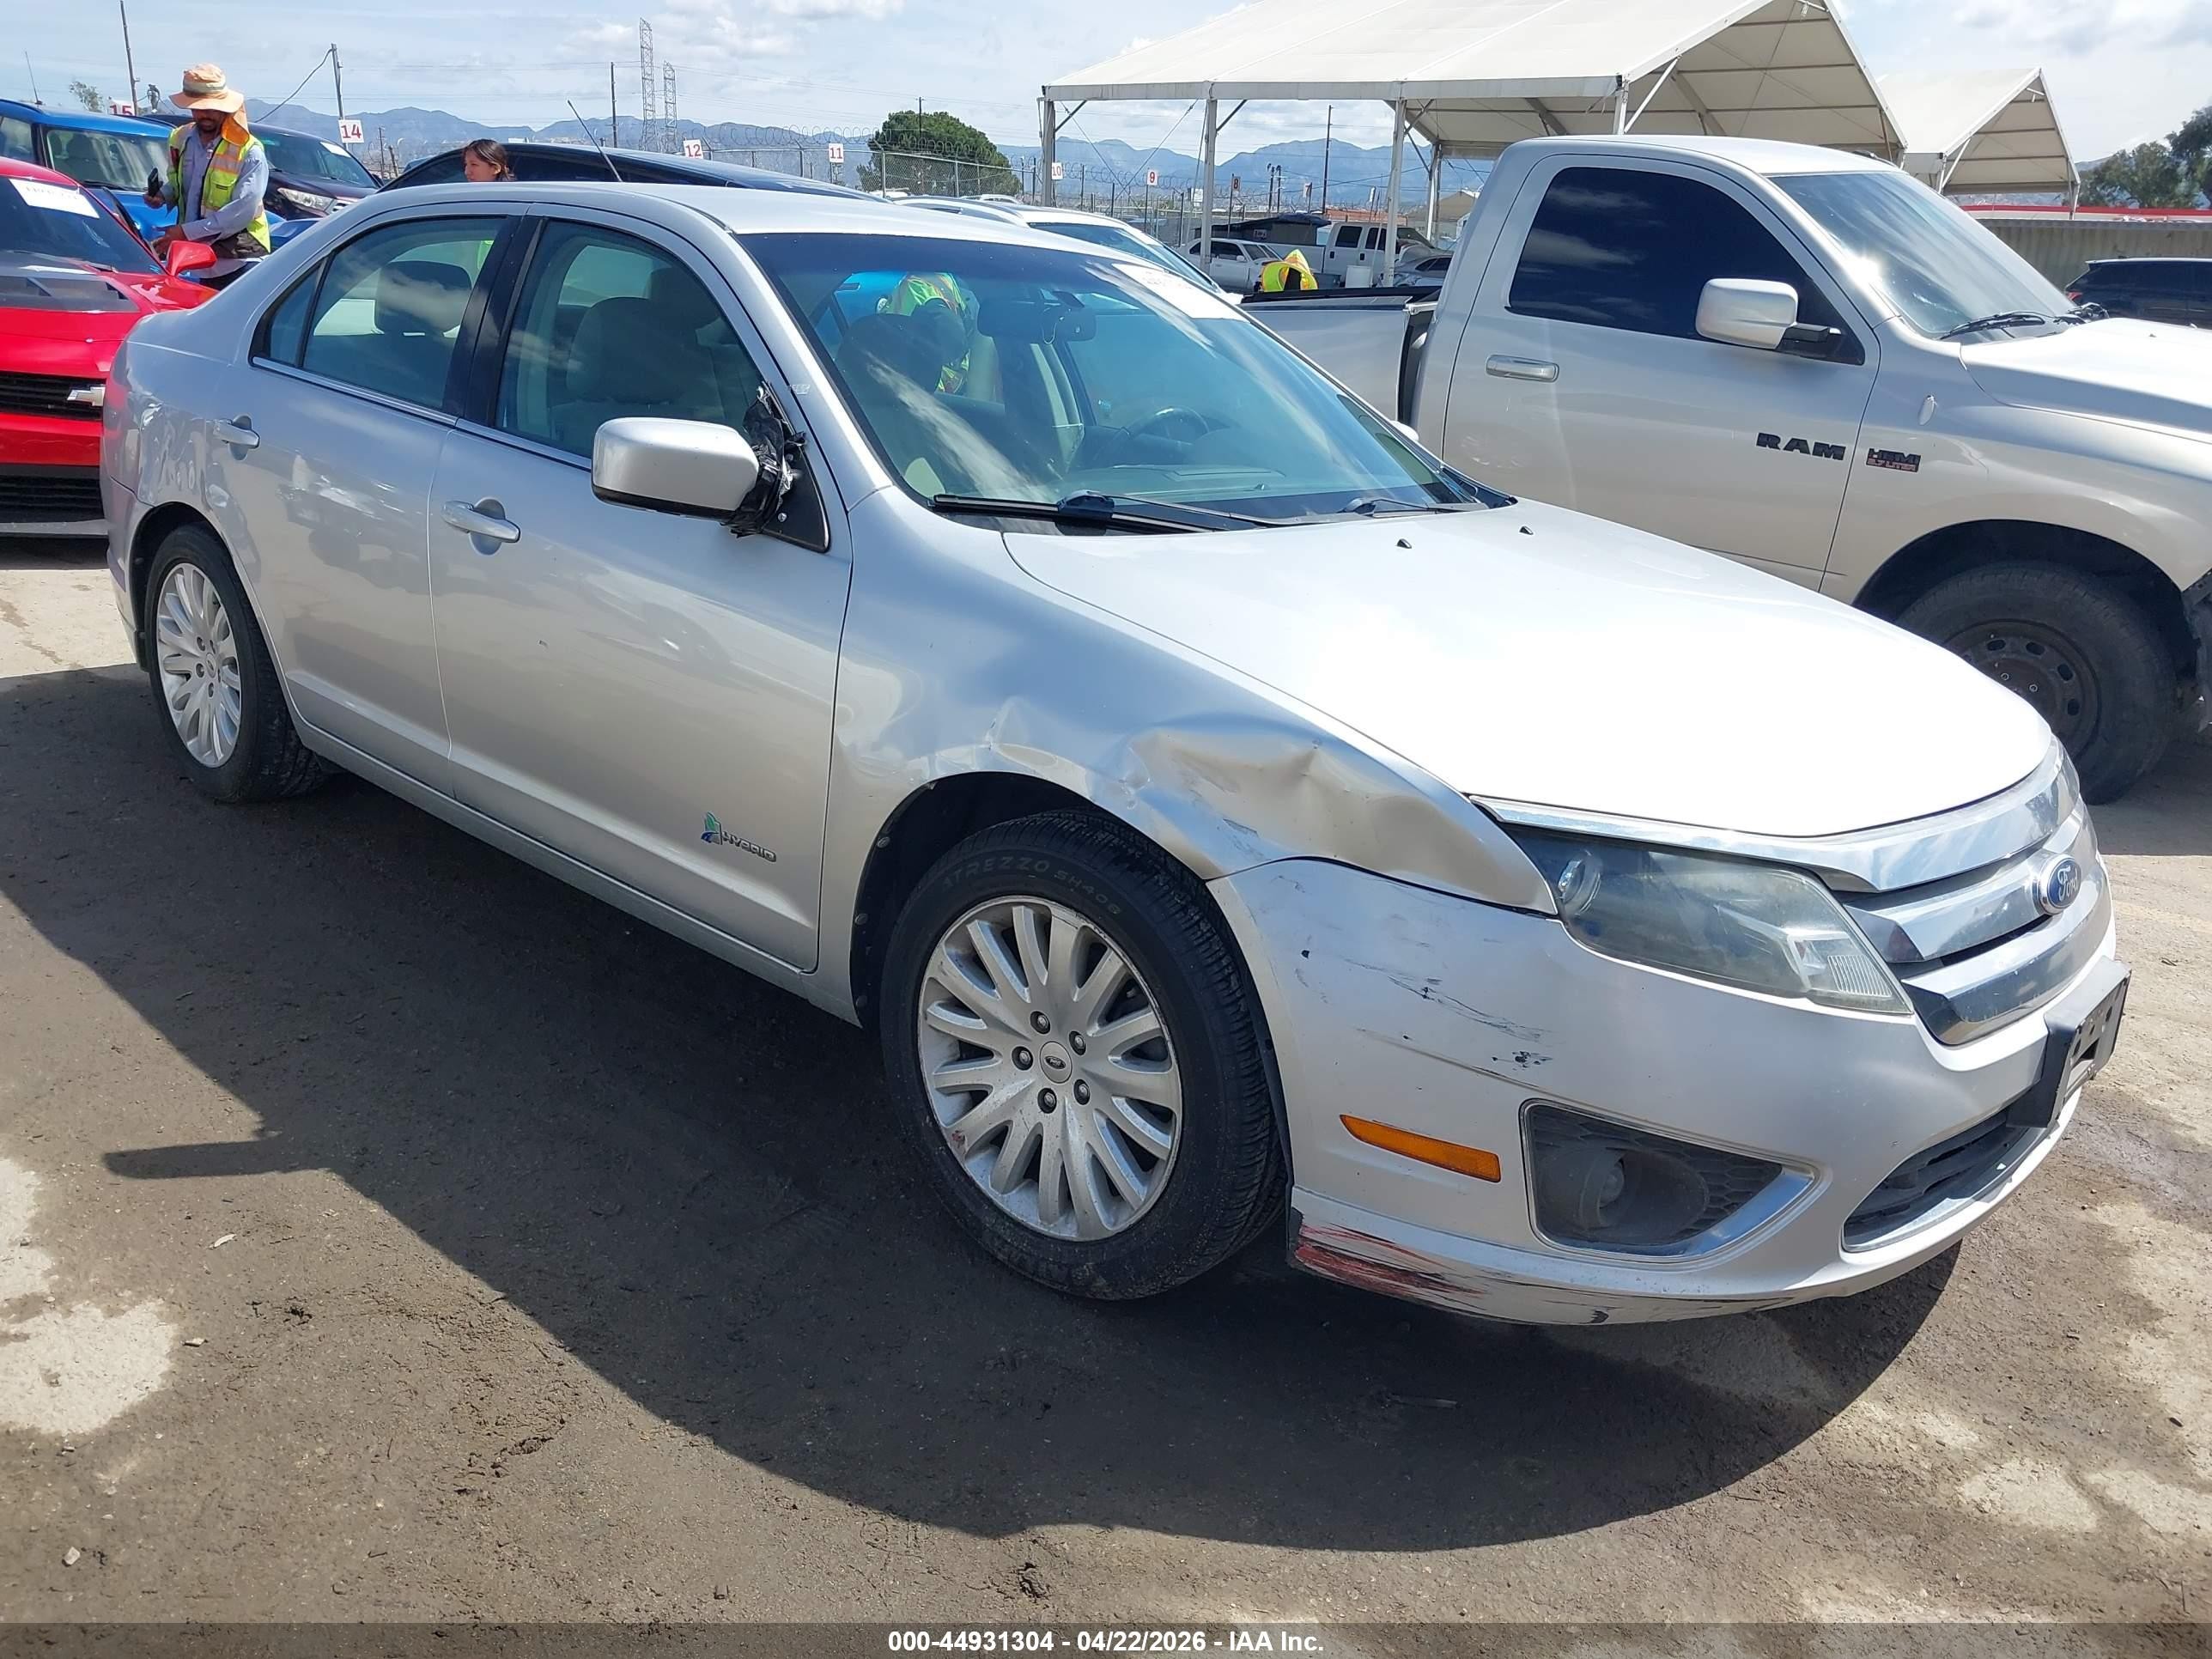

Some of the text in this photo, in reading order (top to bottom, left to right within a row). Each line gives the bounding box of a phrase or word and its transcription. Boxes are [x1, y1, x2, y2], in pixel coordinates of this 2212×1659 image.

[110, 104, 133, 115] 15
[341, 125, 362, 138] 14
[686, 144, 702, 157] 12
[830, 147, 843, 159] 11
[1052, 166, 1061, 176] 10
[1150, 172, 1155, 183] 9
[1233, 178, 1239, 189] 8
[1756, 432, 1846, 461] RAM
[945, 856, 1050, 888] ATREZZO
[2057, 865, 2078, 902] Ford
